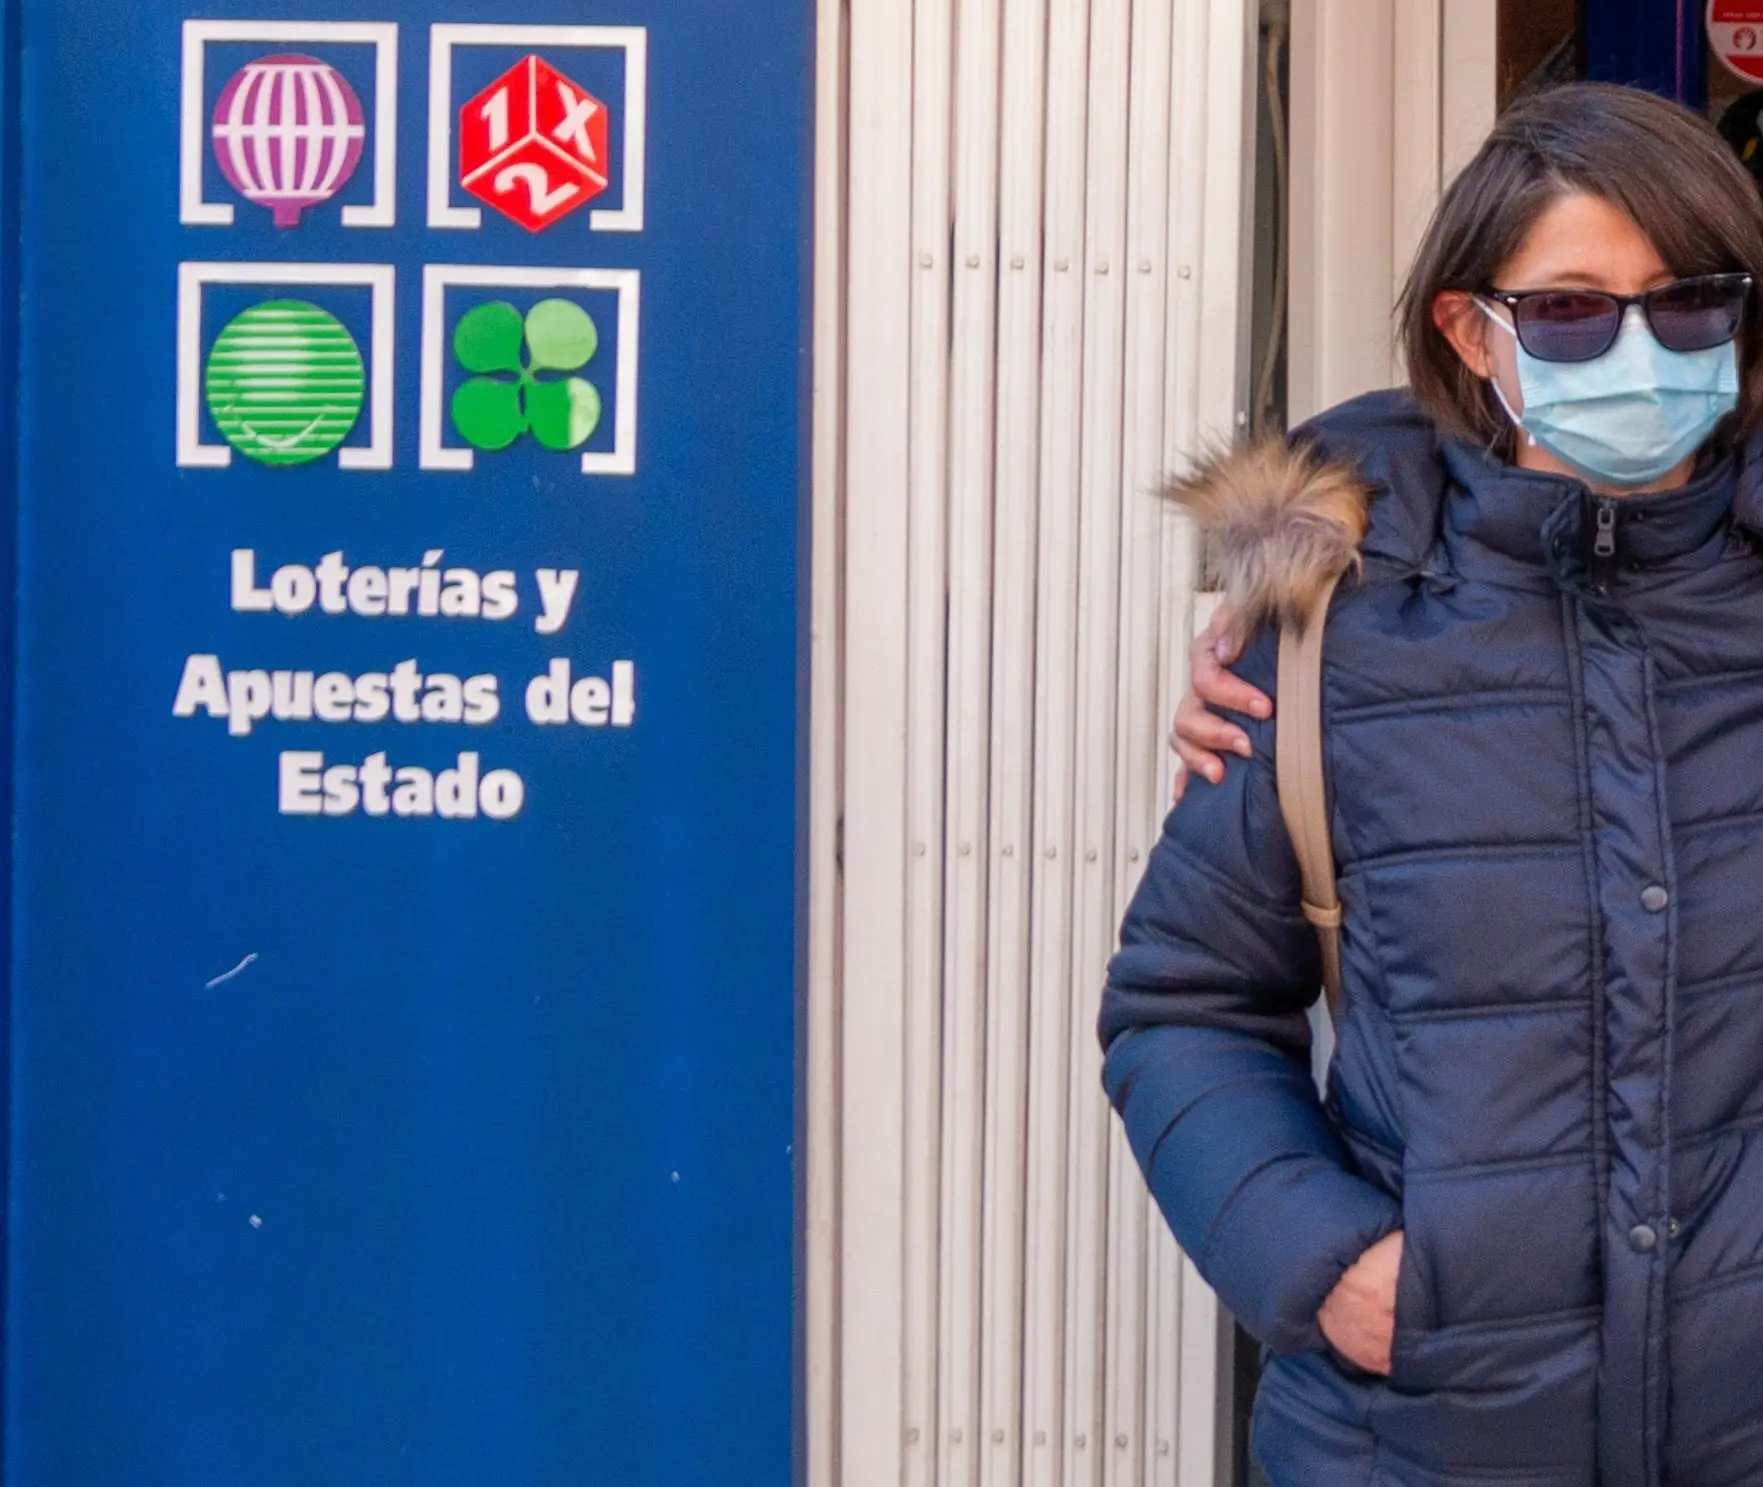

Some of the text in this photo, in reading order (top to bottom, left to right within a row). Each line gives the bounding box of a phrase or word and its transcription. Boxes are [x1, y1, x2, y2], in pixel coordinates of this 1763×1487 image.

[230, 548, 582, 635] Loterías y
[172, 654, 637, 736] Apuestas del
[278, 749, 526, 820] Estado
